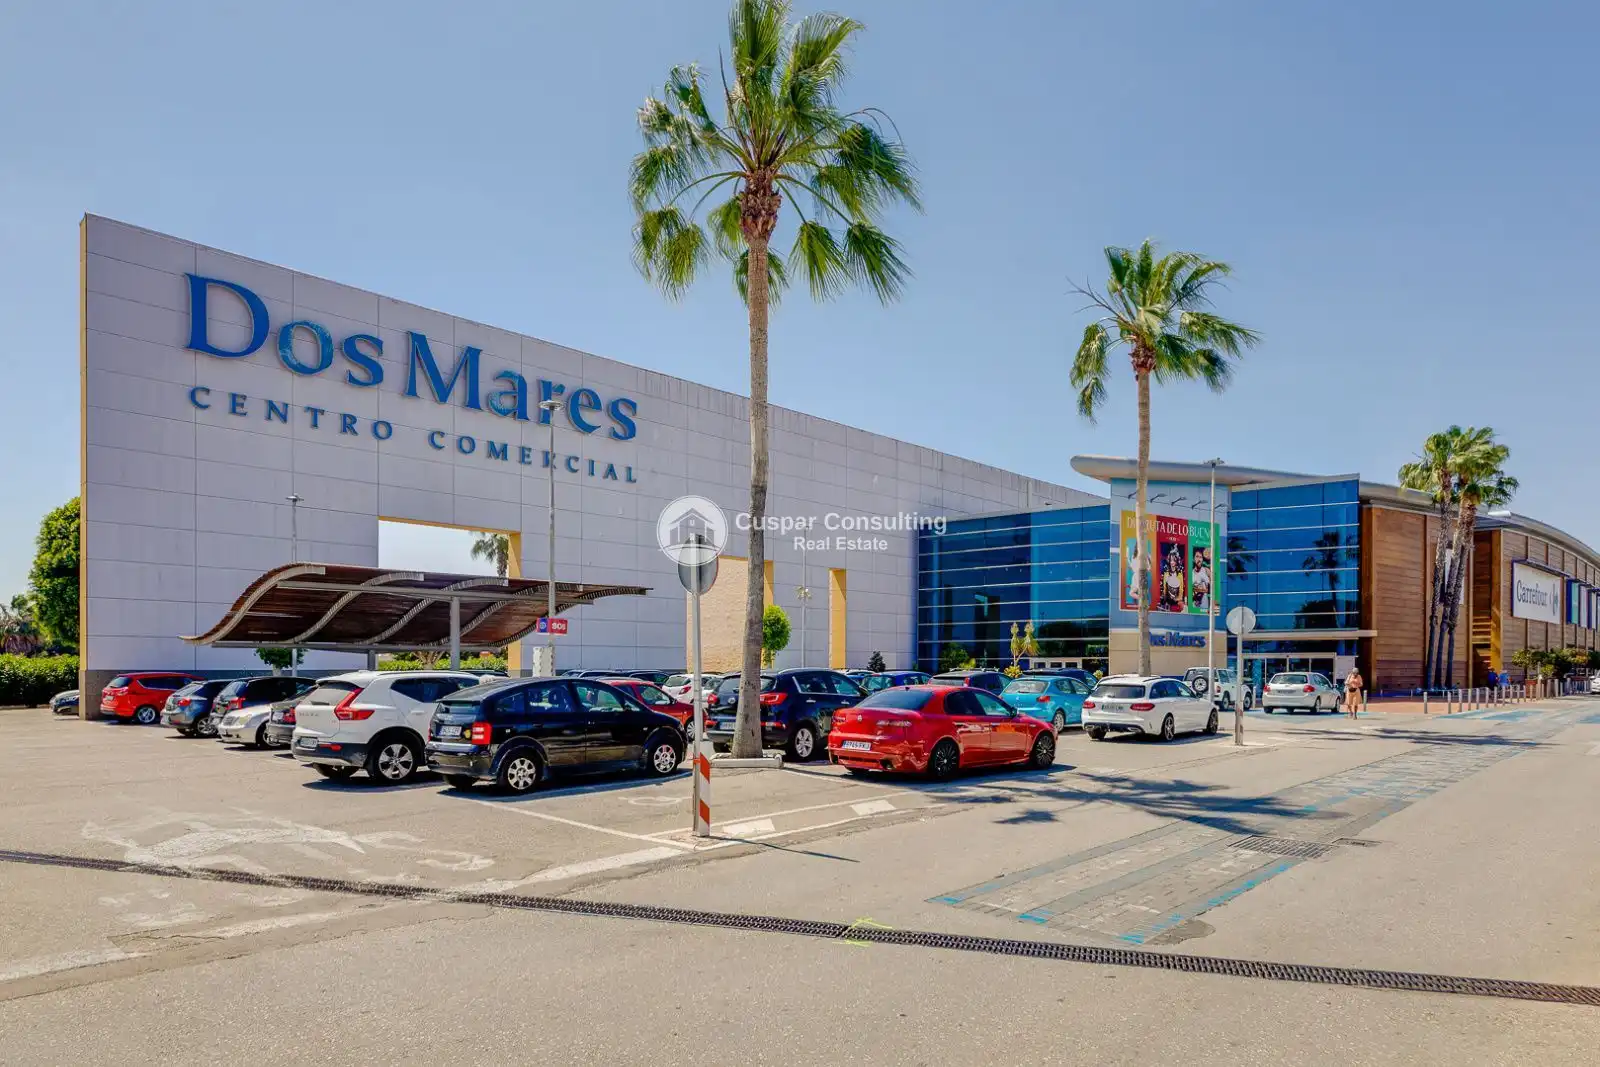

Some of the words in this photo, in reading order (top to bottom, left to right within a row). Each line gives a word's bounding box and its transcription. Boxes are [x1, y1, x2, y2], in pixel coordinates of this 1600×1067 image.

[184, 272, 385, 388] Dos
[405, 331, 638, 441] Mares
[188, 386, 393, 441] CENTRO
[428, 430, 638, 484] COMERCIAL
